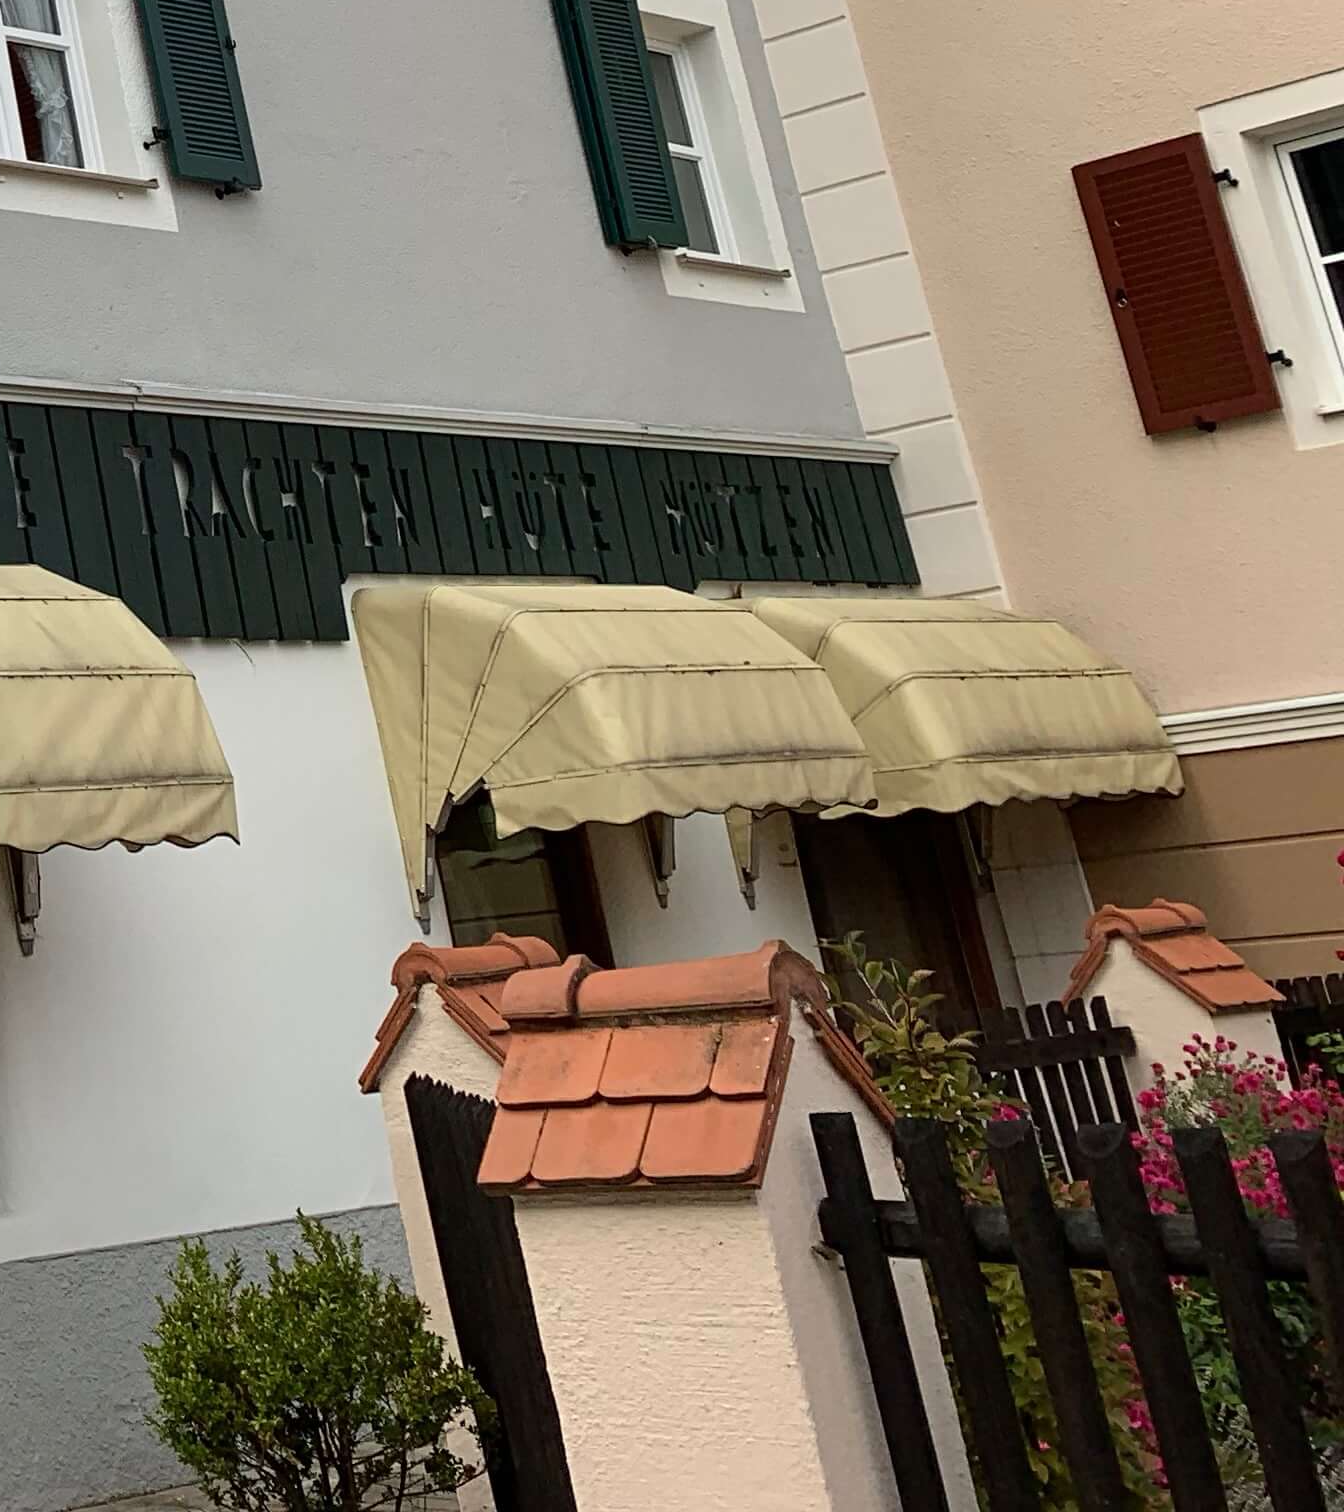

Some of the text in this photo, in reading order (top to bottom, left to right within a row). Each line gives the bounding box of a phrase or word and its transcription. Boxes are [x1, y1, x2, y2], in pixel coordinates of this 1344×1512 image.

[121, 443, 420, 548] TRACHTEN
[472, 468, 611, 551] HÜTE
[660, 480, 835, 559] MÜTZEN
